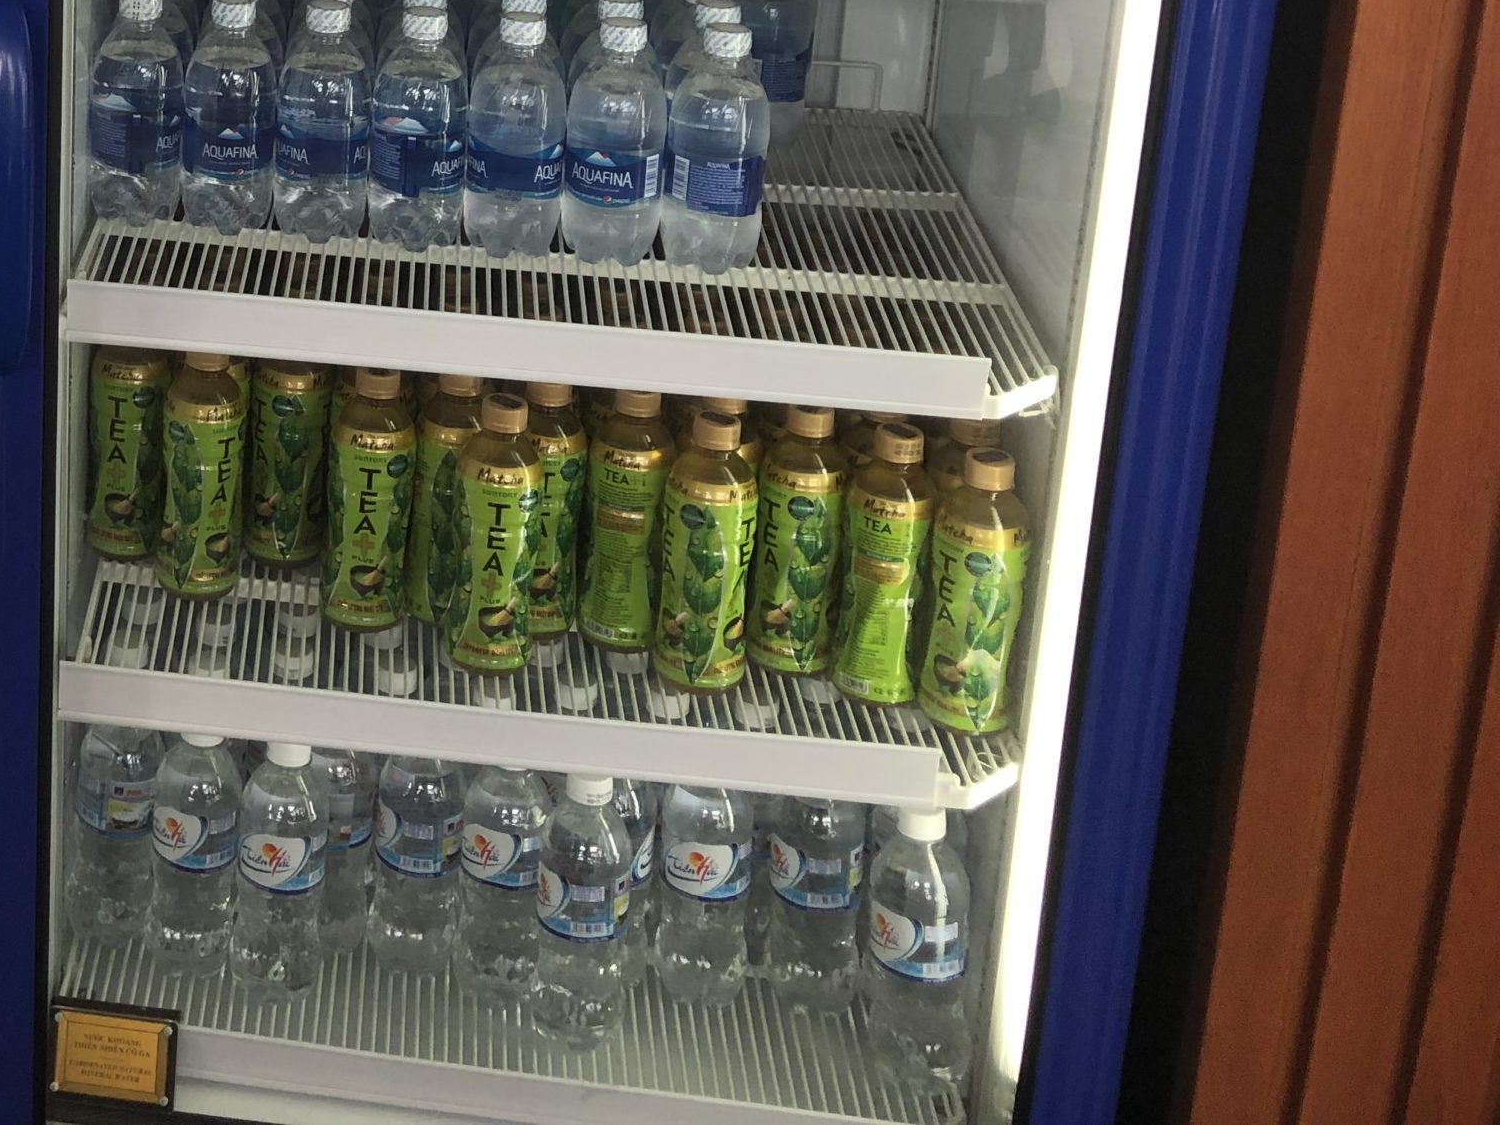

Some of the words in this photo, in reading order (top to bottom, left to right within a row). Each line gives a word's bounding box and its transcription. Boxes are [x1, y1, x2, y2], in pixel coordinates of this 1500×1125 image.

[202, 141, 259, 161] AQUAFINA
[571, 161, 635, 190] AQUAFINA
[107, 395, 137, 464] TEA
[210, 435, 237, 506] TEA
[604, 468, 631, 487] TEA
[354, 466, 382, 536] TEA
[863, 497, 907, 521] Matcha
[863, 515, 892, 536] TEA
[482, 501, 512, 577] TEA
[937, 549, 958, 628] TEA
